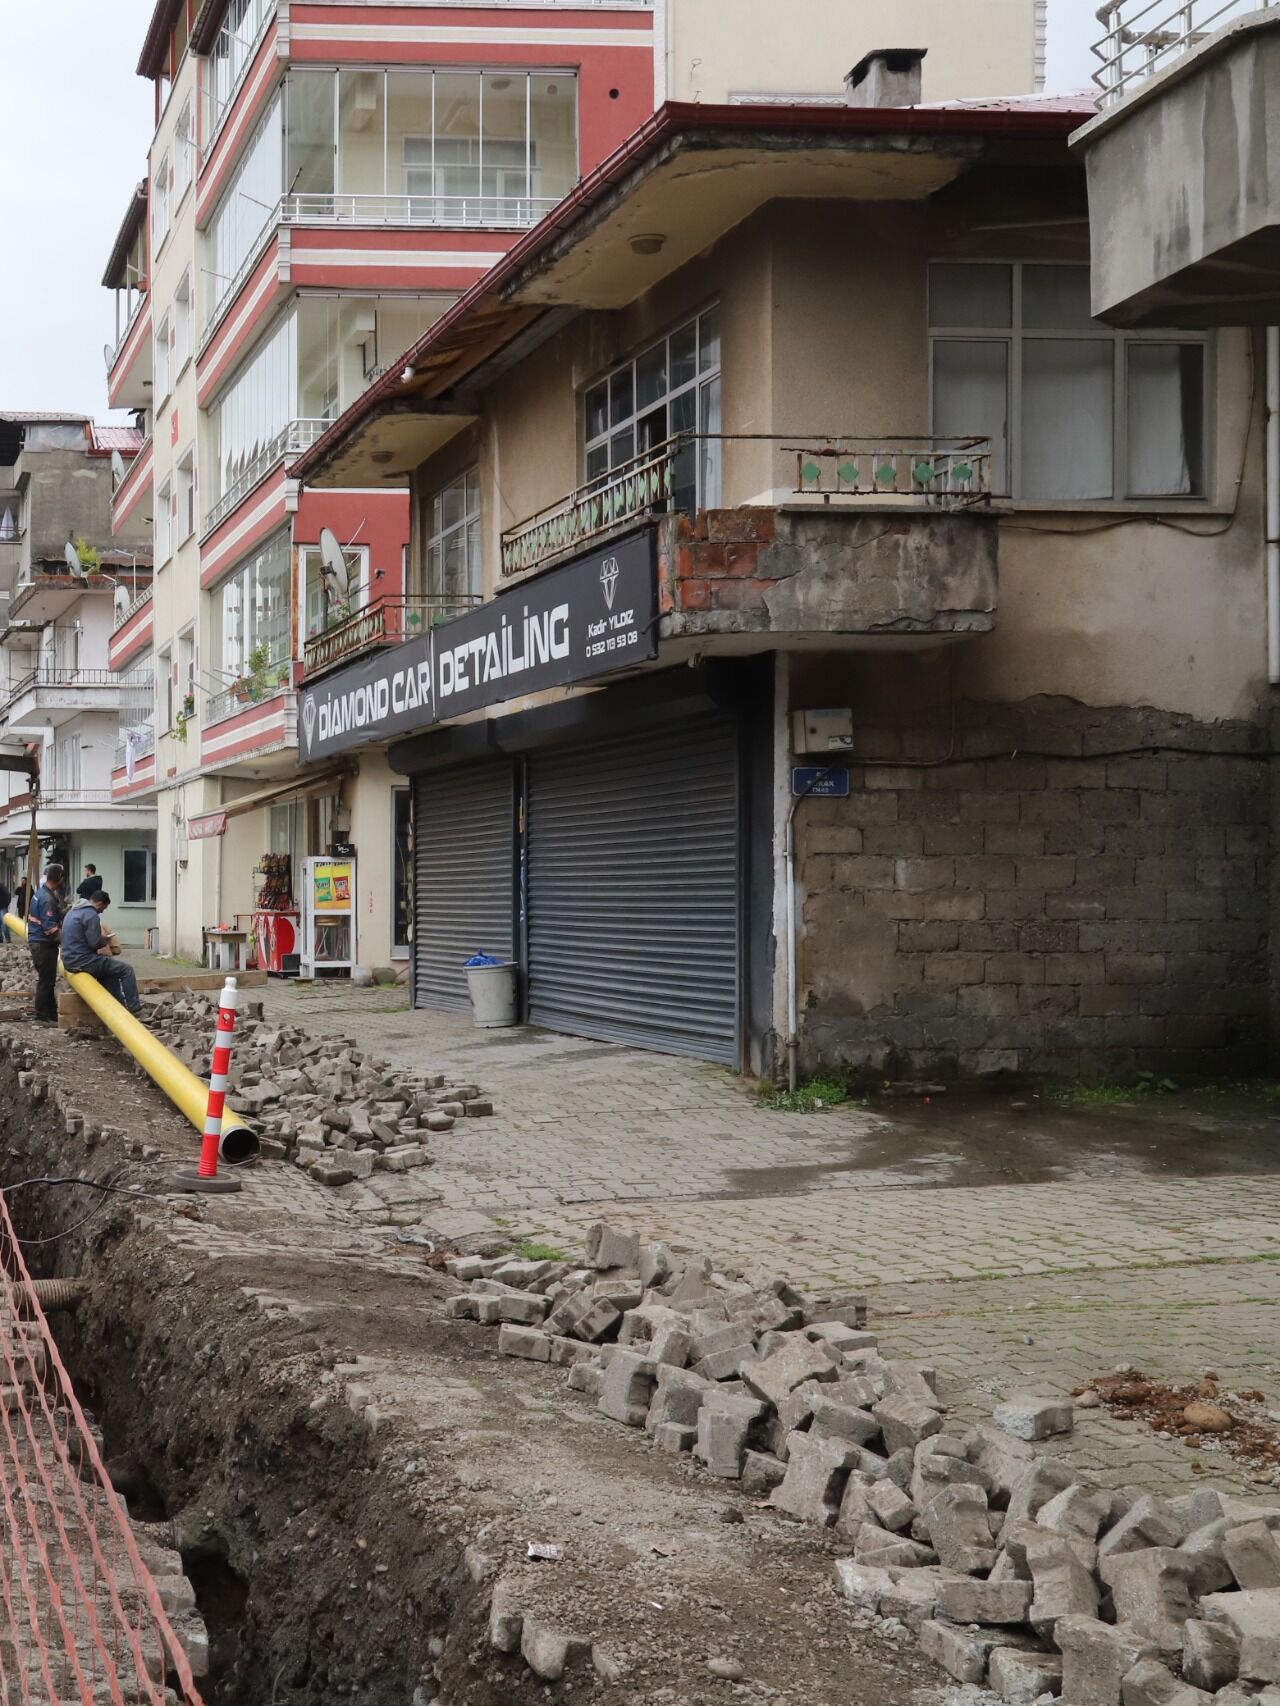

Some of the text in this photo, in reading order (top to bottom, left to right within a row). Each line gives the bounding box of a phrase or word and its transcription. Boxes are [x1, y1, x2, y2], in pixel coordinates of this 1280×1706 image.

[588, 609, 634, 638] Kadir YILDIZ
[586, 646, 591, 658] 0
[592, 641, 606, 656] 532
[617, 634, 626, 648] 53
[628, 630, 638, 645] 08
[319, 603, 570, 741] DİAMOND CAR DETAİLİNG
